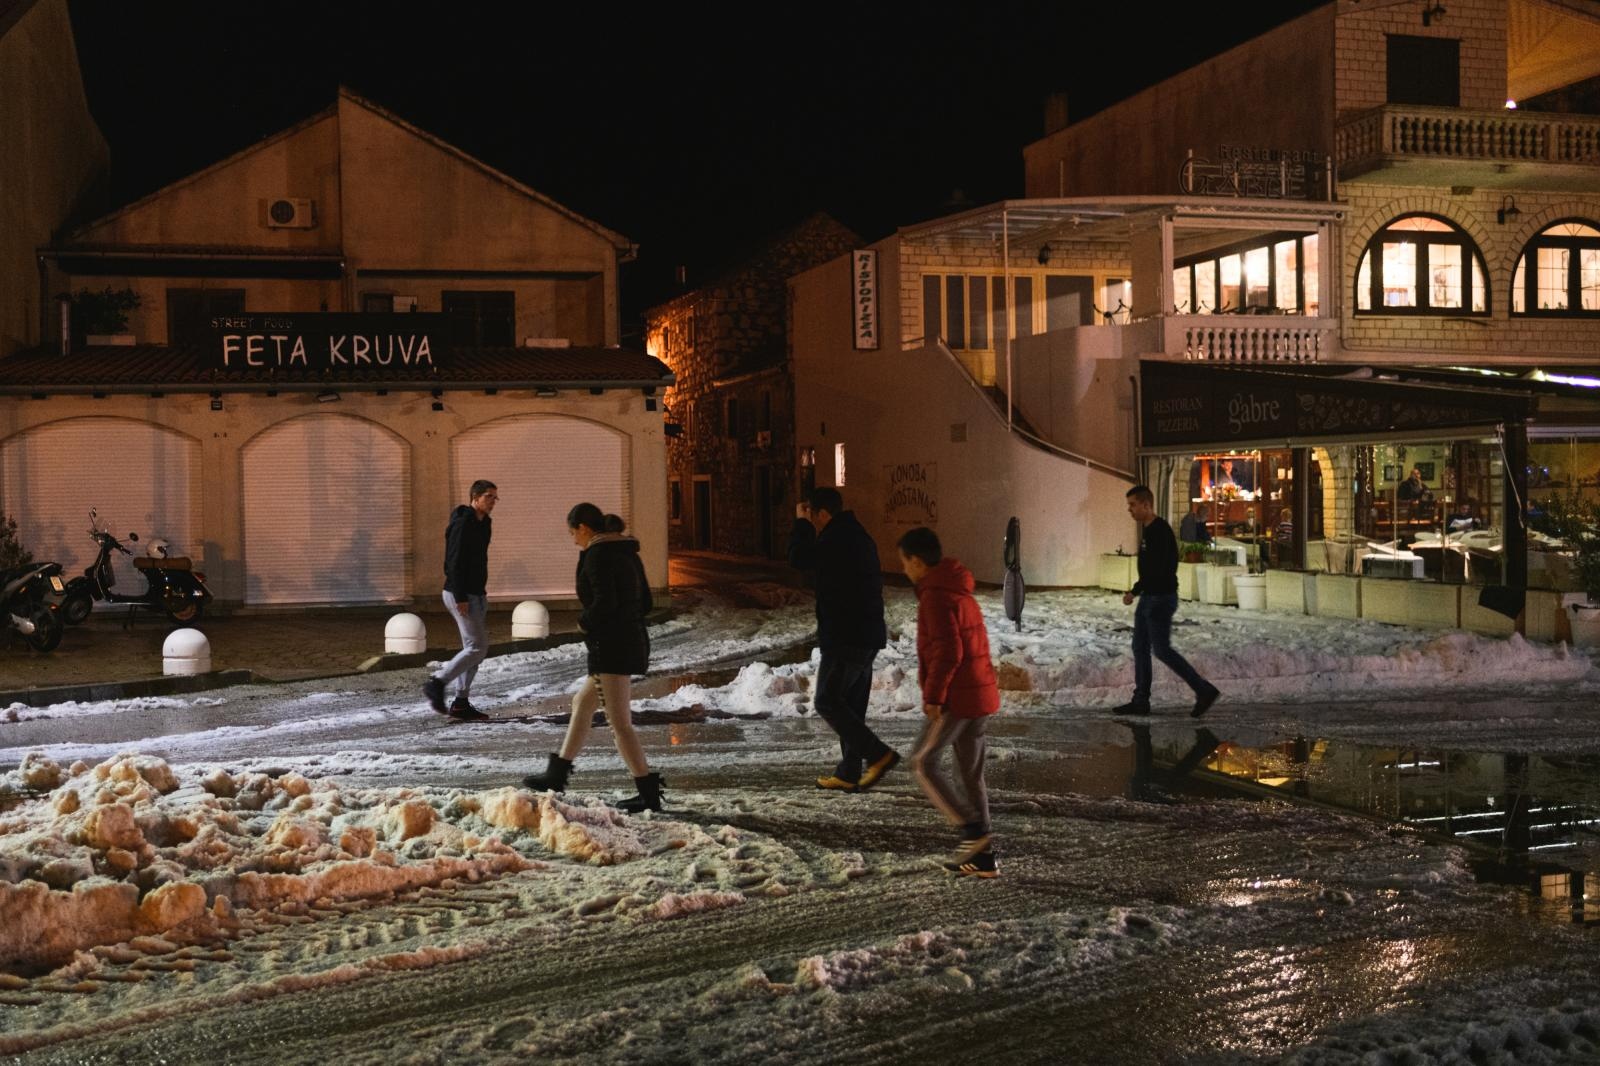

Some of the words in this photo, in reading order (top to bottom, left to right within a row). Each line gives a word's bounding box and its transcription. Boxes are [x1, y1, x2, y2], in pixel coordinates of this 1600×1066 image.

[858, 254, 872, 338] RISTOPIZZA
[222, 334, 307, 366] FETA
[328, 334, 433, 366] KRUVA
[1153, 397, 1202, 415] RESTORAN
[1157, 416, 1200, 433] PIZZERIA
[890, 464, 927, 486] KONOBA
